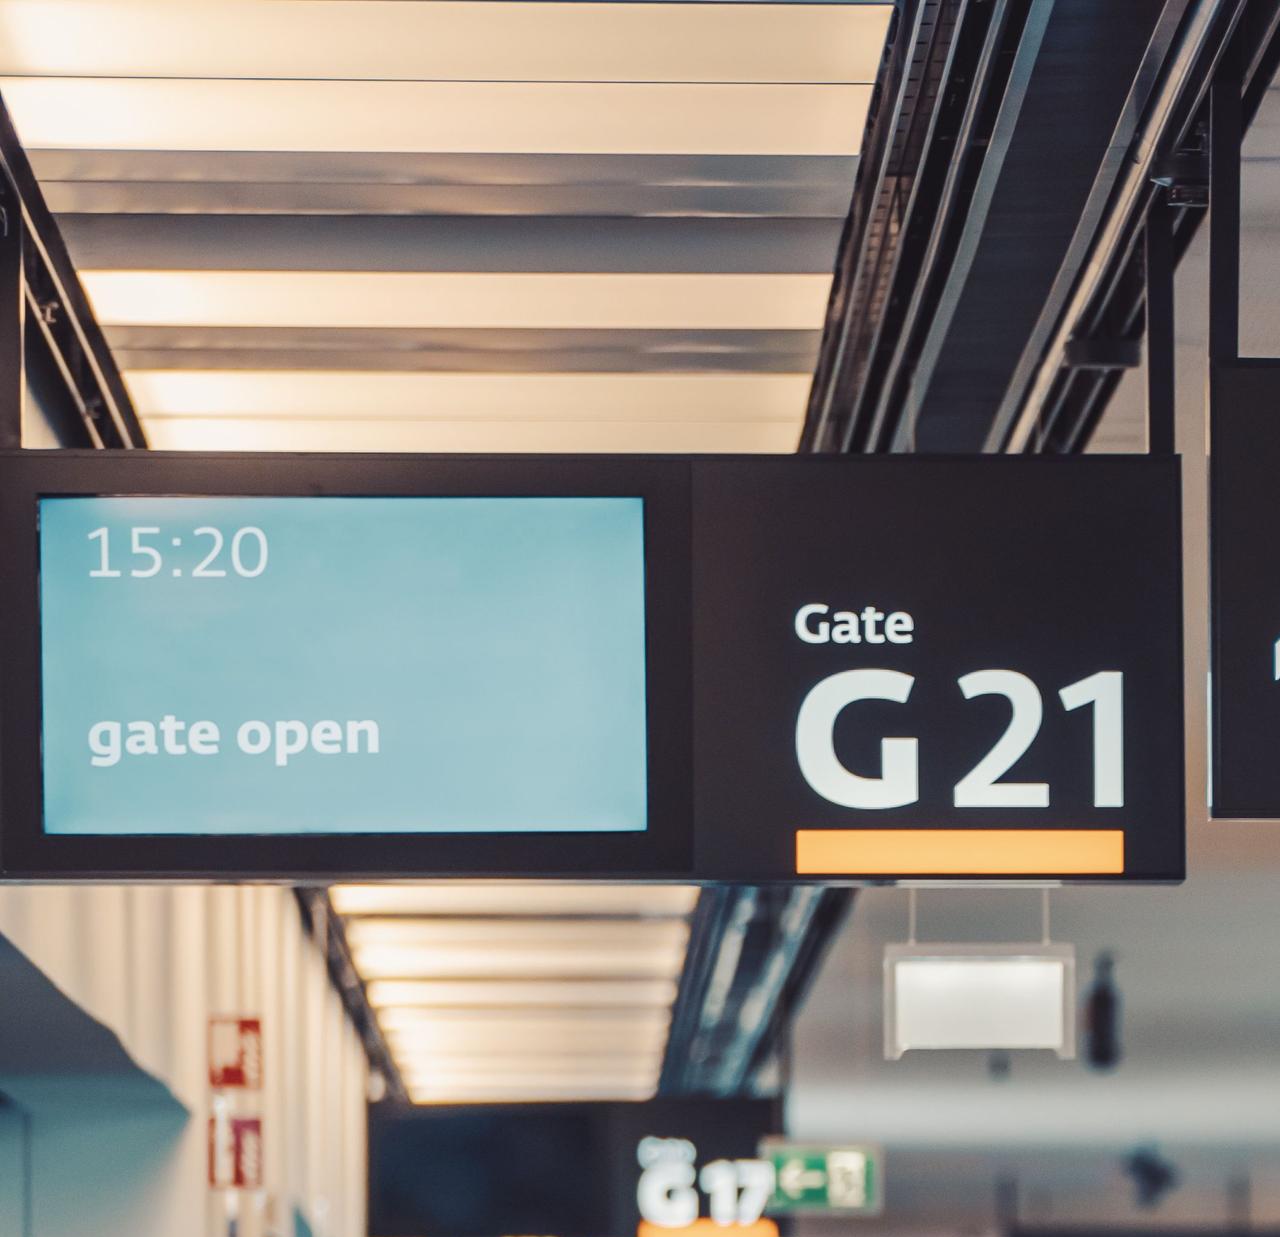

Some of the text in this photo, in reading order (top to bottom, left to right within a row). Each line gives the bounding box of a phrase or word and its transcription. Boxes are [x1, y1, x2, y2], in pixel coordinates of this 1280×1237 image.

[88, 526, 269, 578] 15:20
[794, 602, 915, 645] Gate
[88, 714, 380, 767] gate open
[795, 668, 1125, 810] G 21
[637, 1158, 777, 1229] G 17
